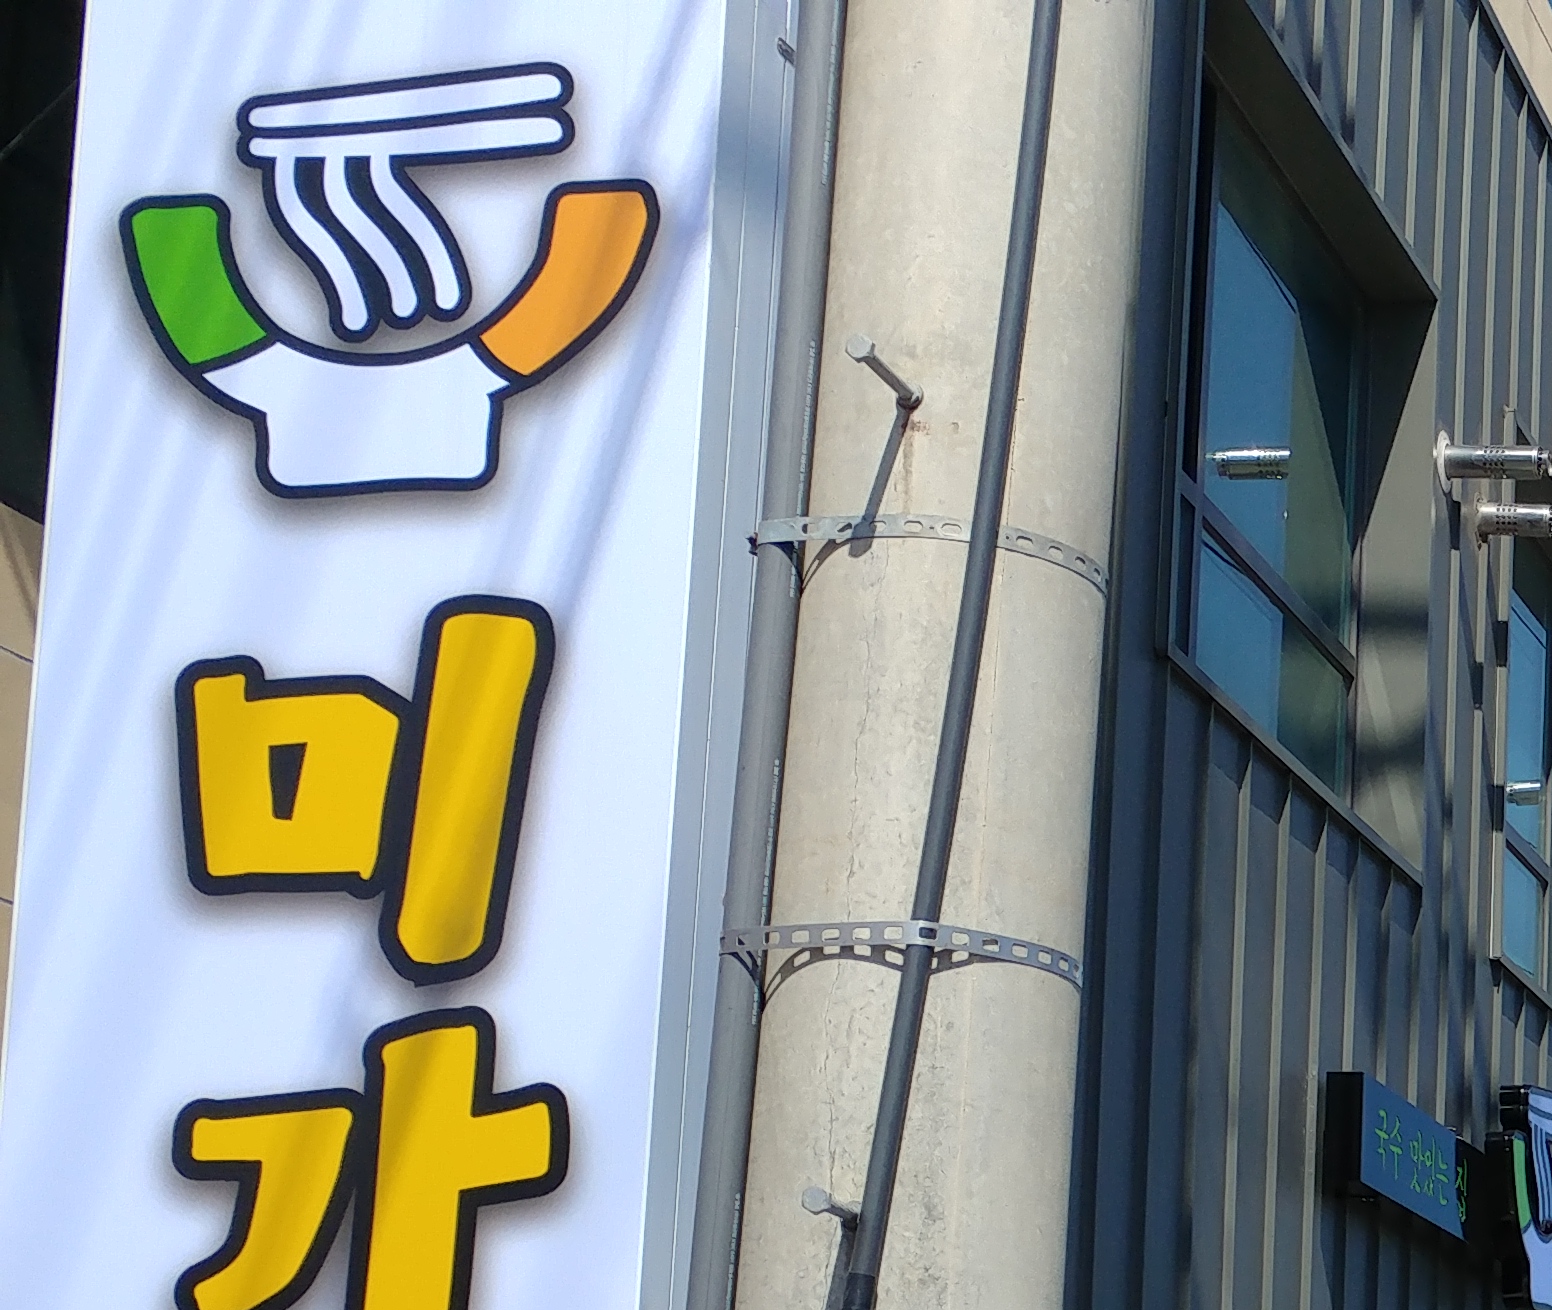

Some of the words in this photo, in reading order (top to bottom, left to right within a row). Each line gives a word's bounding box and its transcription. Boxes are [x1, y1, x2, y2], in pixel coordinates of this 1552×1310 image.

[1375, 1109, 1403, 1181] 국수
[1409, 1130, 1449, 1205] 맛있는
[1455, 1158, 1467, 1223] 집
